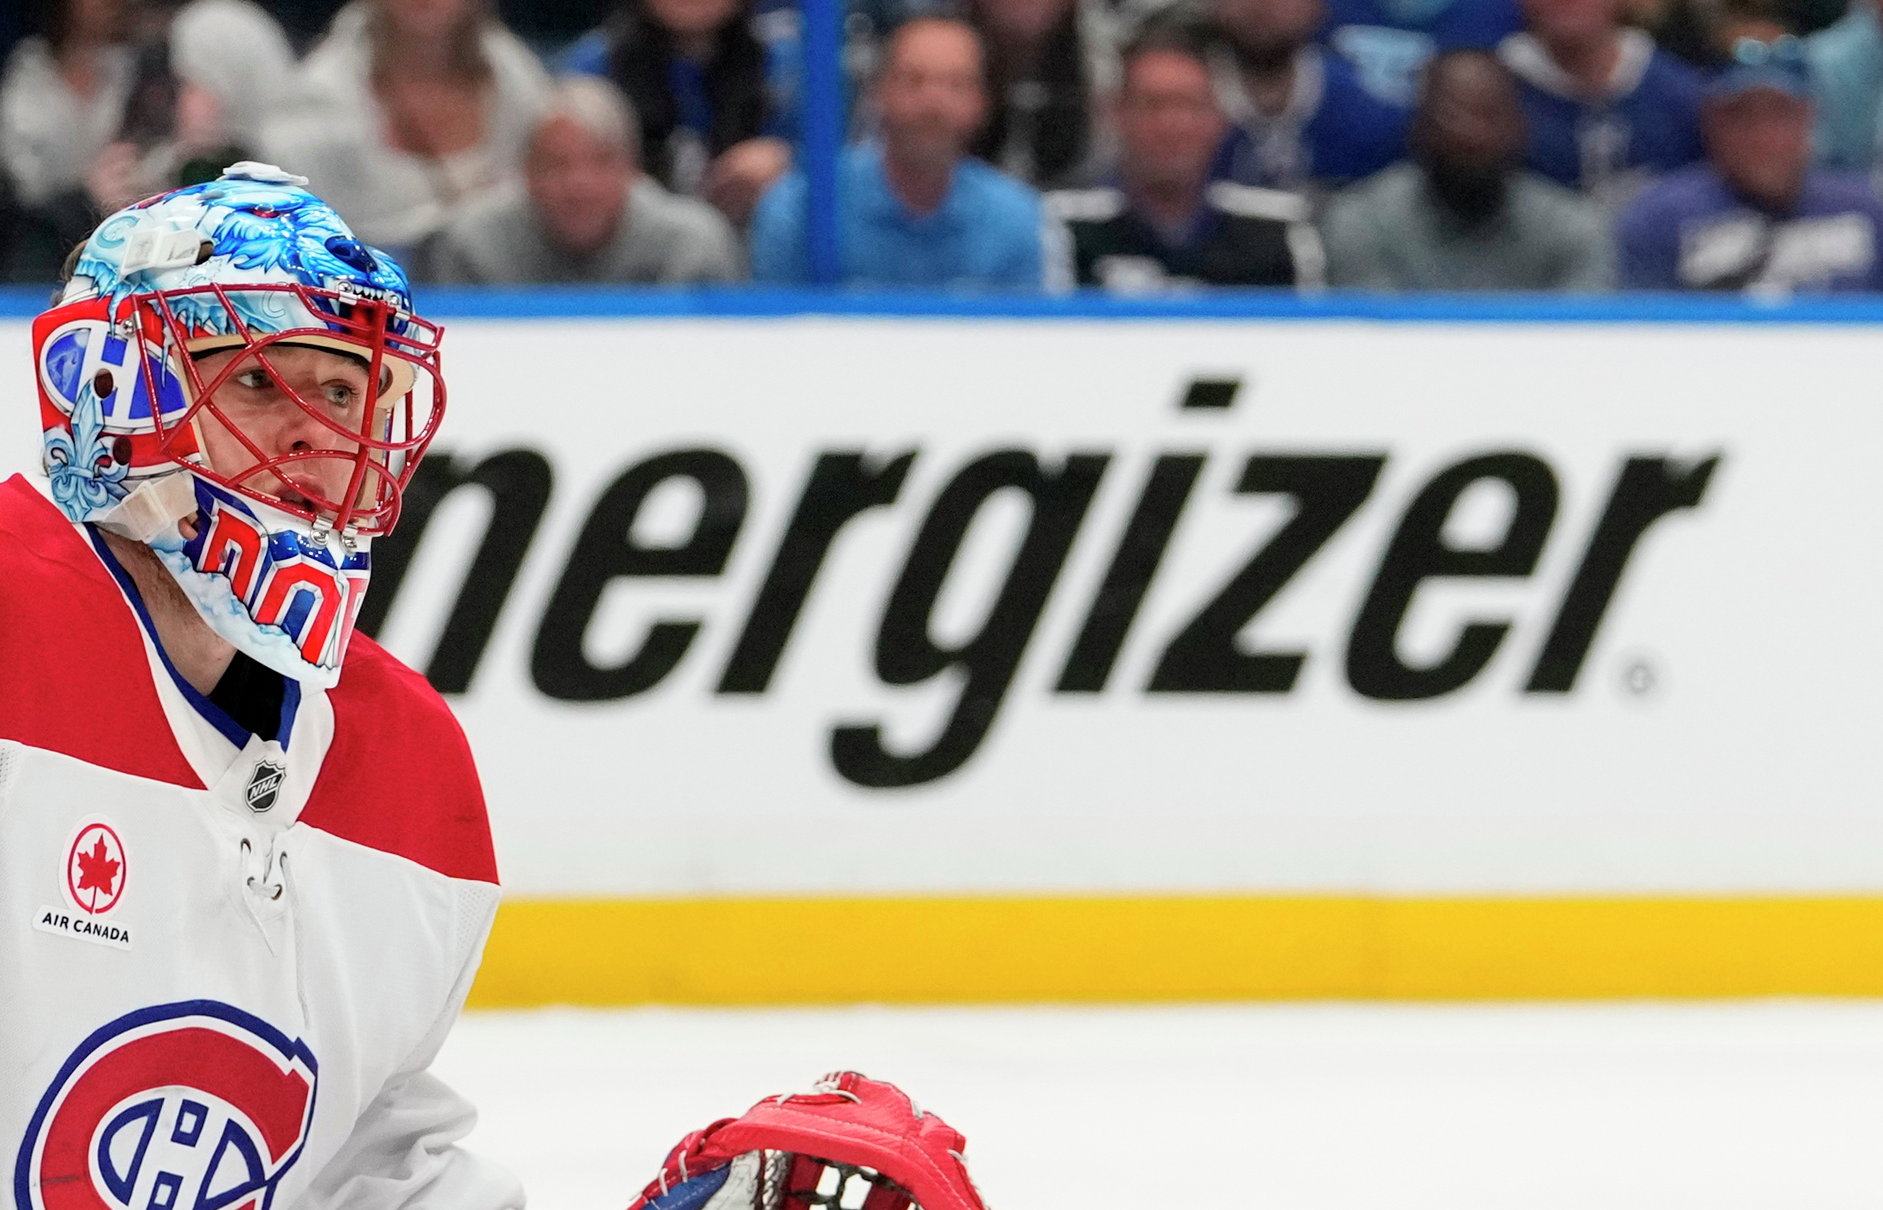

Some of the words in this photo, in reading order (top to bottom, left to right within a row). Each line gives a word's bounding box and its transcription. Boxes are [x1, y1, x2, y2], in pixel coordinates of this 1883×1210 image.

[354, 377, 1724, 787] nergizer
[249, 776, 278, 800] NHL
[42, 912, 69, 931] AIR
[73, 919, 129, 943] CANADA
